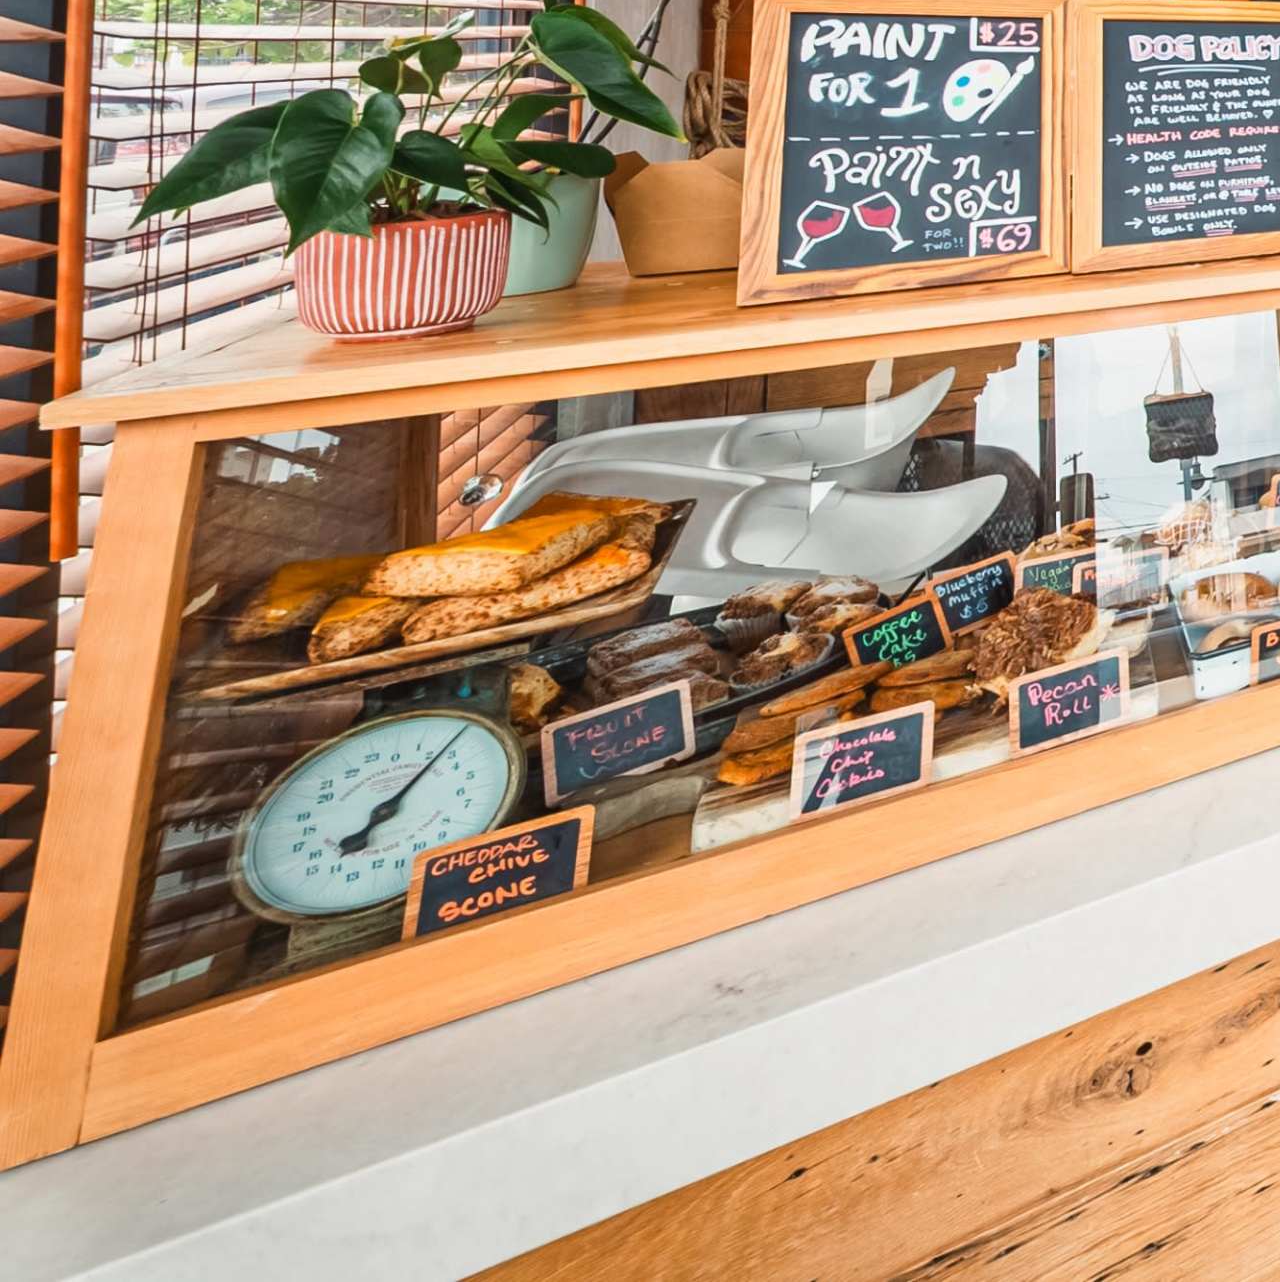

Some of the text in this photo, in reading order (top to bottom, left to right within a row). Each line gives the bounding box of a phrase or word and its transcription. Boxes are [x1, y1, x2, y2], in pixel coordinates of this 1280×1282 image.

[800, 18, 1039, 63] PAINT $25
[1128, 34, 1195, 62] DOG
[808, 68, 930, 118] FOR 1
[1125, 75, 1271, 92] WE ARE DOG FRIENDLY
[1127, 88, 1270, 104] AS LONG AS YOUR DOG
[1129, 106, 1143, 115] IS
[1150, 103, 1208, 115] FRIENDLY
[1225, 100, 1248, 110] THE
[1133, 115, 1199, 127] ARE WELL
[1126, 128, 1221, 145] HEALTH CODE
[1143, 144, 1267, 163] DOGS ALLOWED ONLY
[808, 142, 981, 196] Paint n
[925, 168, 1021, 224] Sexy
[1144, 181, 1195, 195] NO DOGS
[1147, 203, 1277, 224] USE DESIGNATED DOG
[922, 236, 965, 253] TWO!!
[924, 228, 951, 240] FOR
[978, 224, 1032, 251] $69
[935, 564, 1003, 598] Blueberry
[1027, 674, 1098, 707] Pecan
[1043, 696, 1092, 730] Roll
[565, 705, 647, 751] FRUIT
[819, 727, 897, 760] Chocolate
[831, 750, 874, 775] Chip
[815, 767, 885, 799] Cookies
[412, 840, 427, 852] 10
[431, 834, 539, 878] CHEDDAR
[468, 851, 550, 884] CHIVE
[438, 875, 537, 923] SCONE
